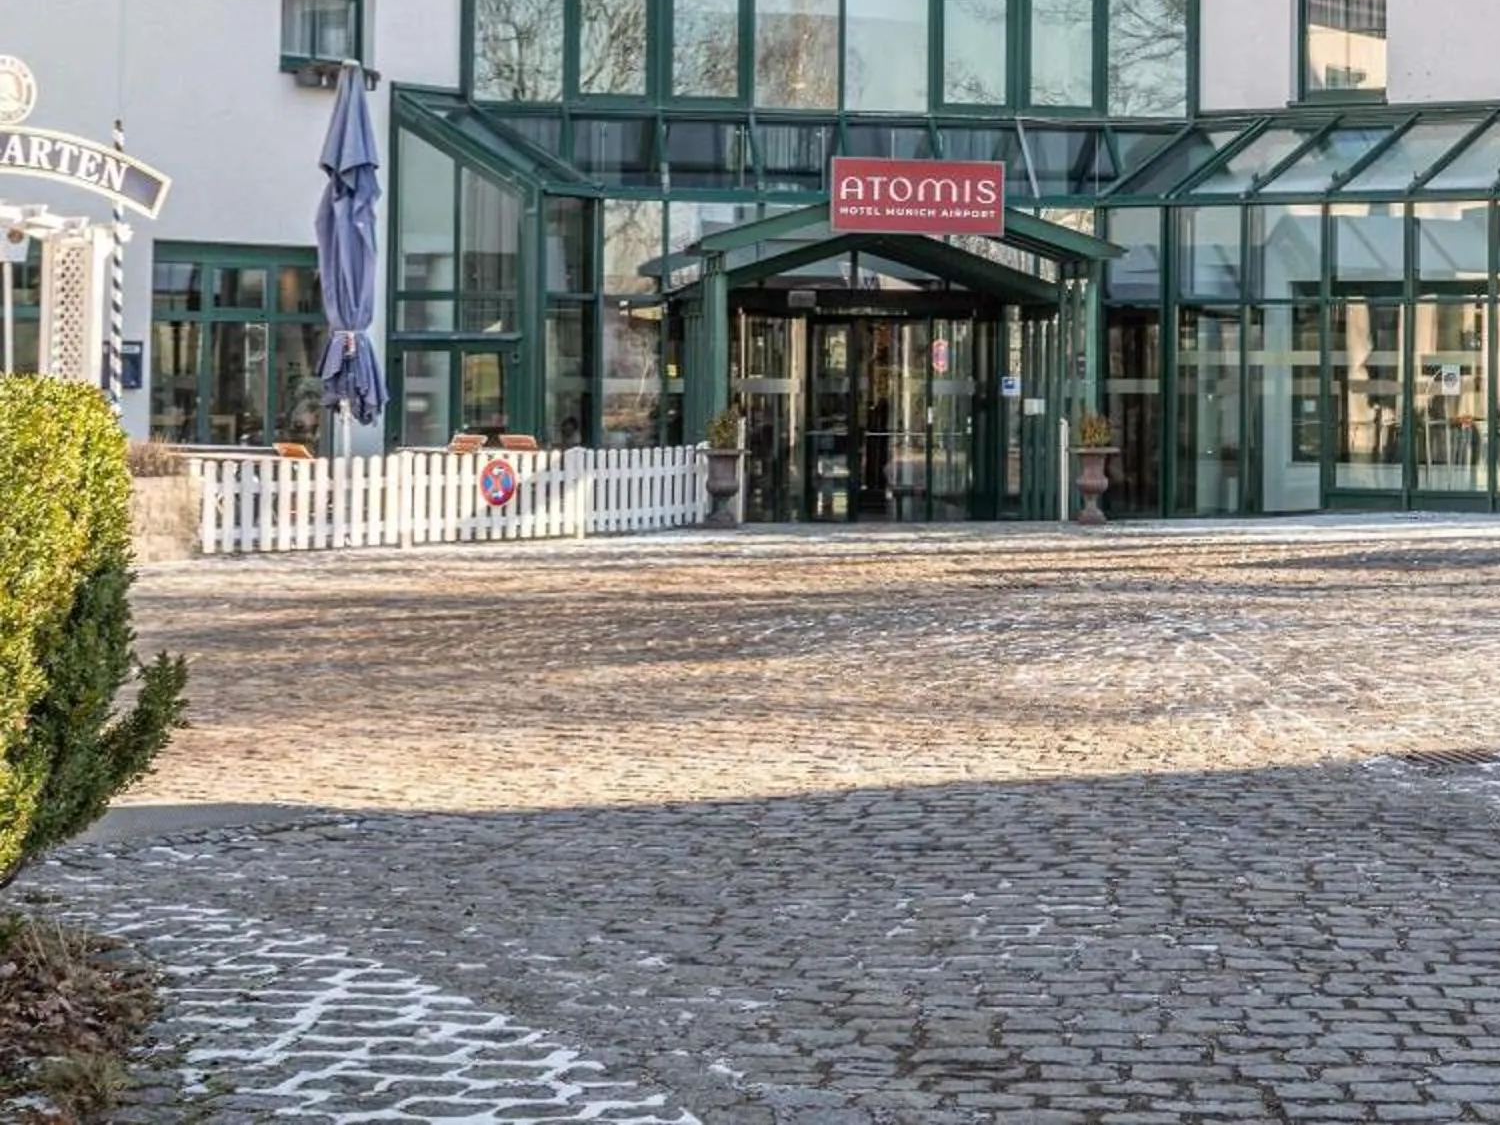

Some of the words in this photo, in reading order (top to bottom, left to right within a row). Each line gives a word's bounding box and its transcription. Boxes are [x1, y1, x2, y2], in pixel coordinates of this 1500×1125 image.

[0, 134, 128, 192] ARTEN
[840, 176, 997, 204] ATOMIS
[840, 206, 881, 216] HOTEL
[885, 208, 937, 217] MUNICH
[941, 209, 996, 219] AIRPORT
